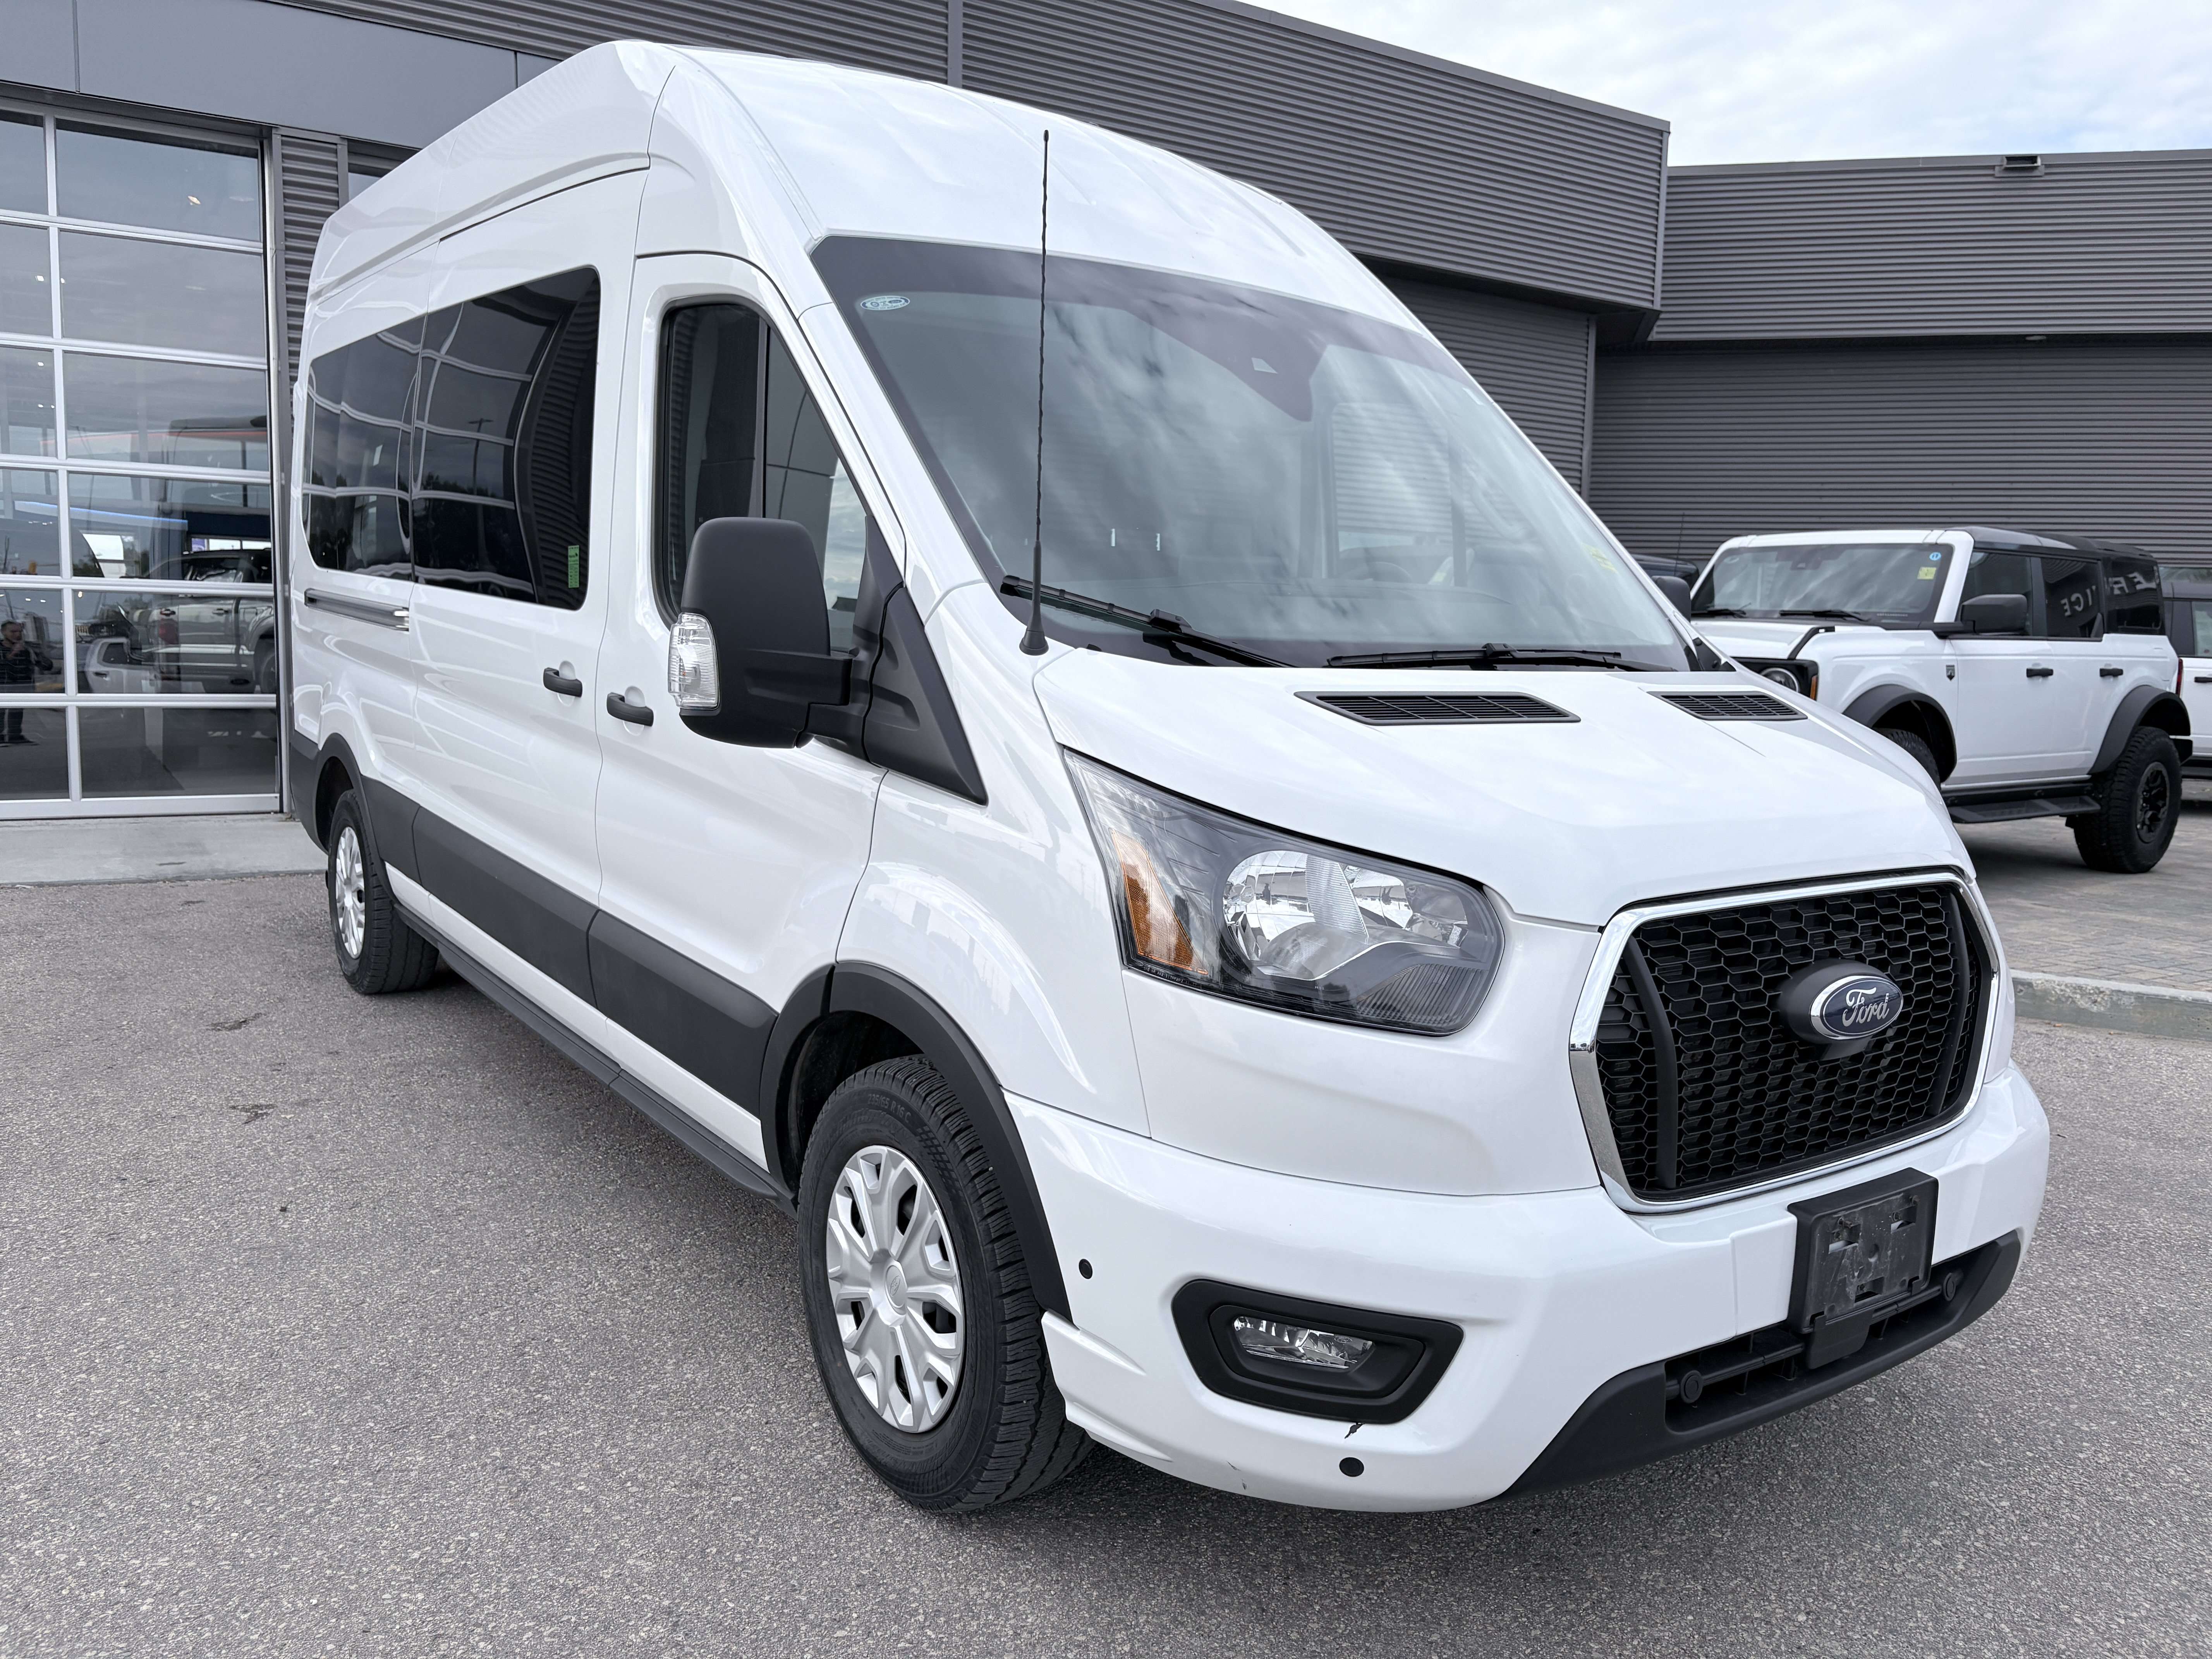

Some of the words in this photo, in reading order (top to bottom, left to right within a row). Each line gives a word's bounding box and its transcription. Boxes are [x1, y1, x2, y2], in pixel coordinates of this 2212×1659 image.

[1842, 987, 1889, 1027] Ford
[891, 1101, 896, 1113] R
[896, 1104, 905, 1118] 16
[905, 1111, 911, 1123] C
